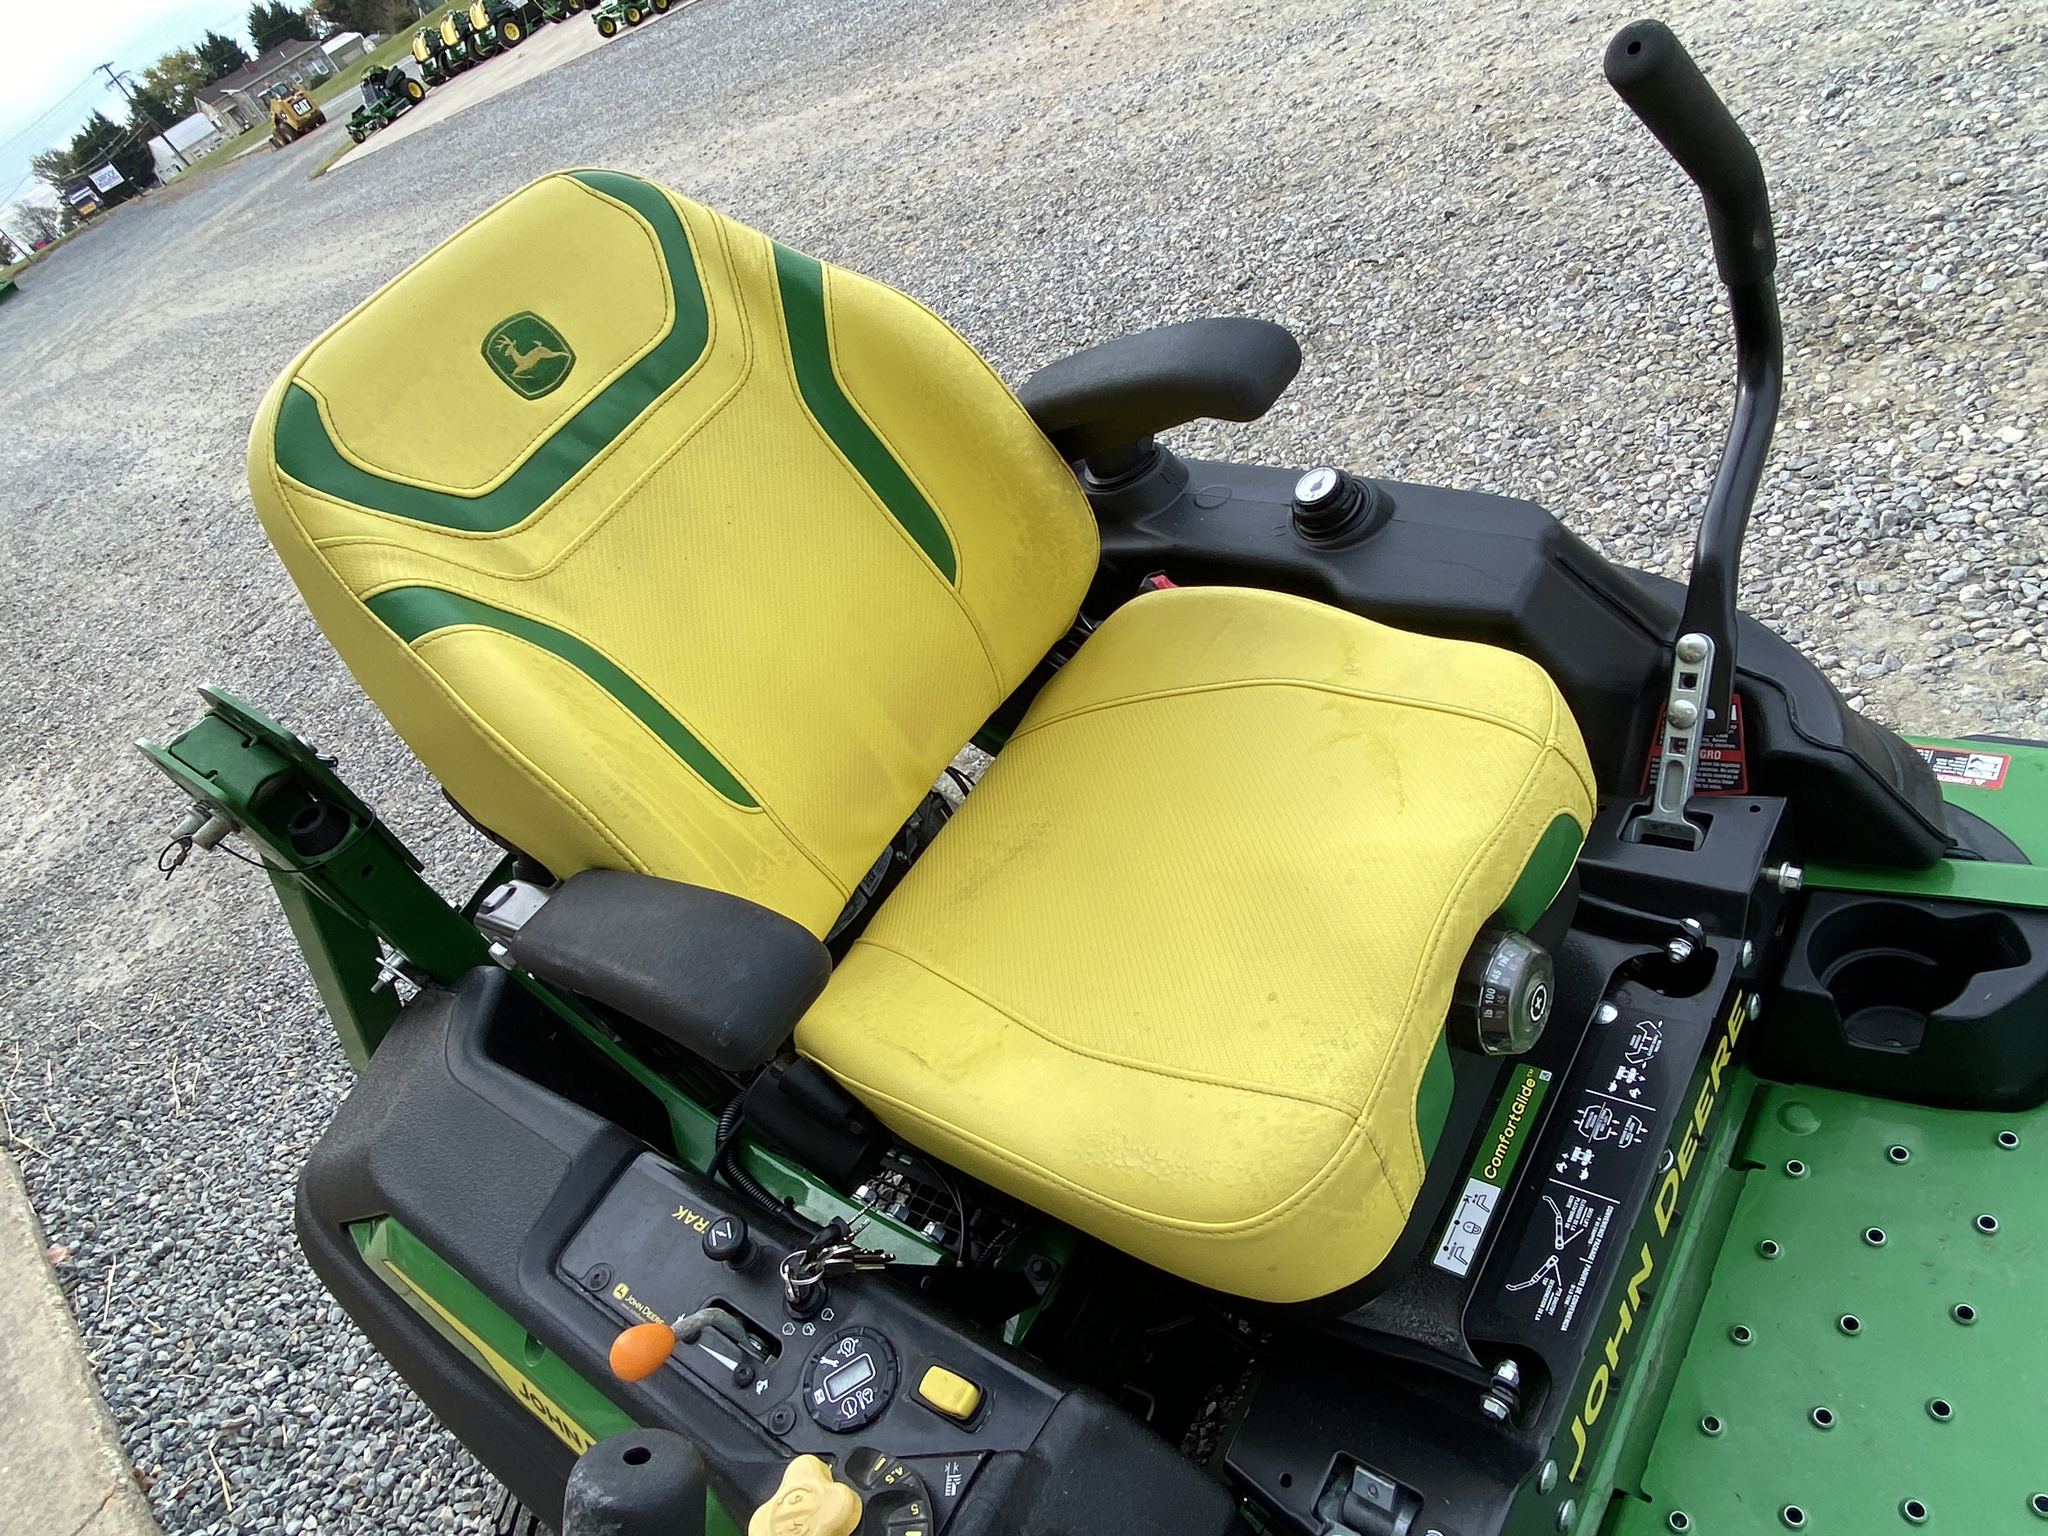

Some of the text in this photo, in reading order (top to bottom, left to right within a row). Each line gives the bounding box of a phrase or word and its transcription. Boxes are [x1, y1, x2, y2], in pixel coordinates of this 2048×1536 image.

[1490, 969, 1502, 984] 145
[1485, 988, 1496, 1004] 100
[1484, 1009, 1493, 1018] lb
[671, 1205, 710, 1234] RAK
[1569, 989, 1746, 1483] JOHN DEERE
[1587, 1237, 1601, 1260] PACKAGE
[1577, 1263, 1591, 1286] PAQUETE
[1574, 1286, 1582, 1294] DE
[625, 1295, 645, 1312] JOHN
[1534, 1313, 1541, 1321] LA
[518, 1381, 583, 1450] JOHN
[884, 1466, 904, 1485] 4.5
[910, 1503, 919, 1516] 5
